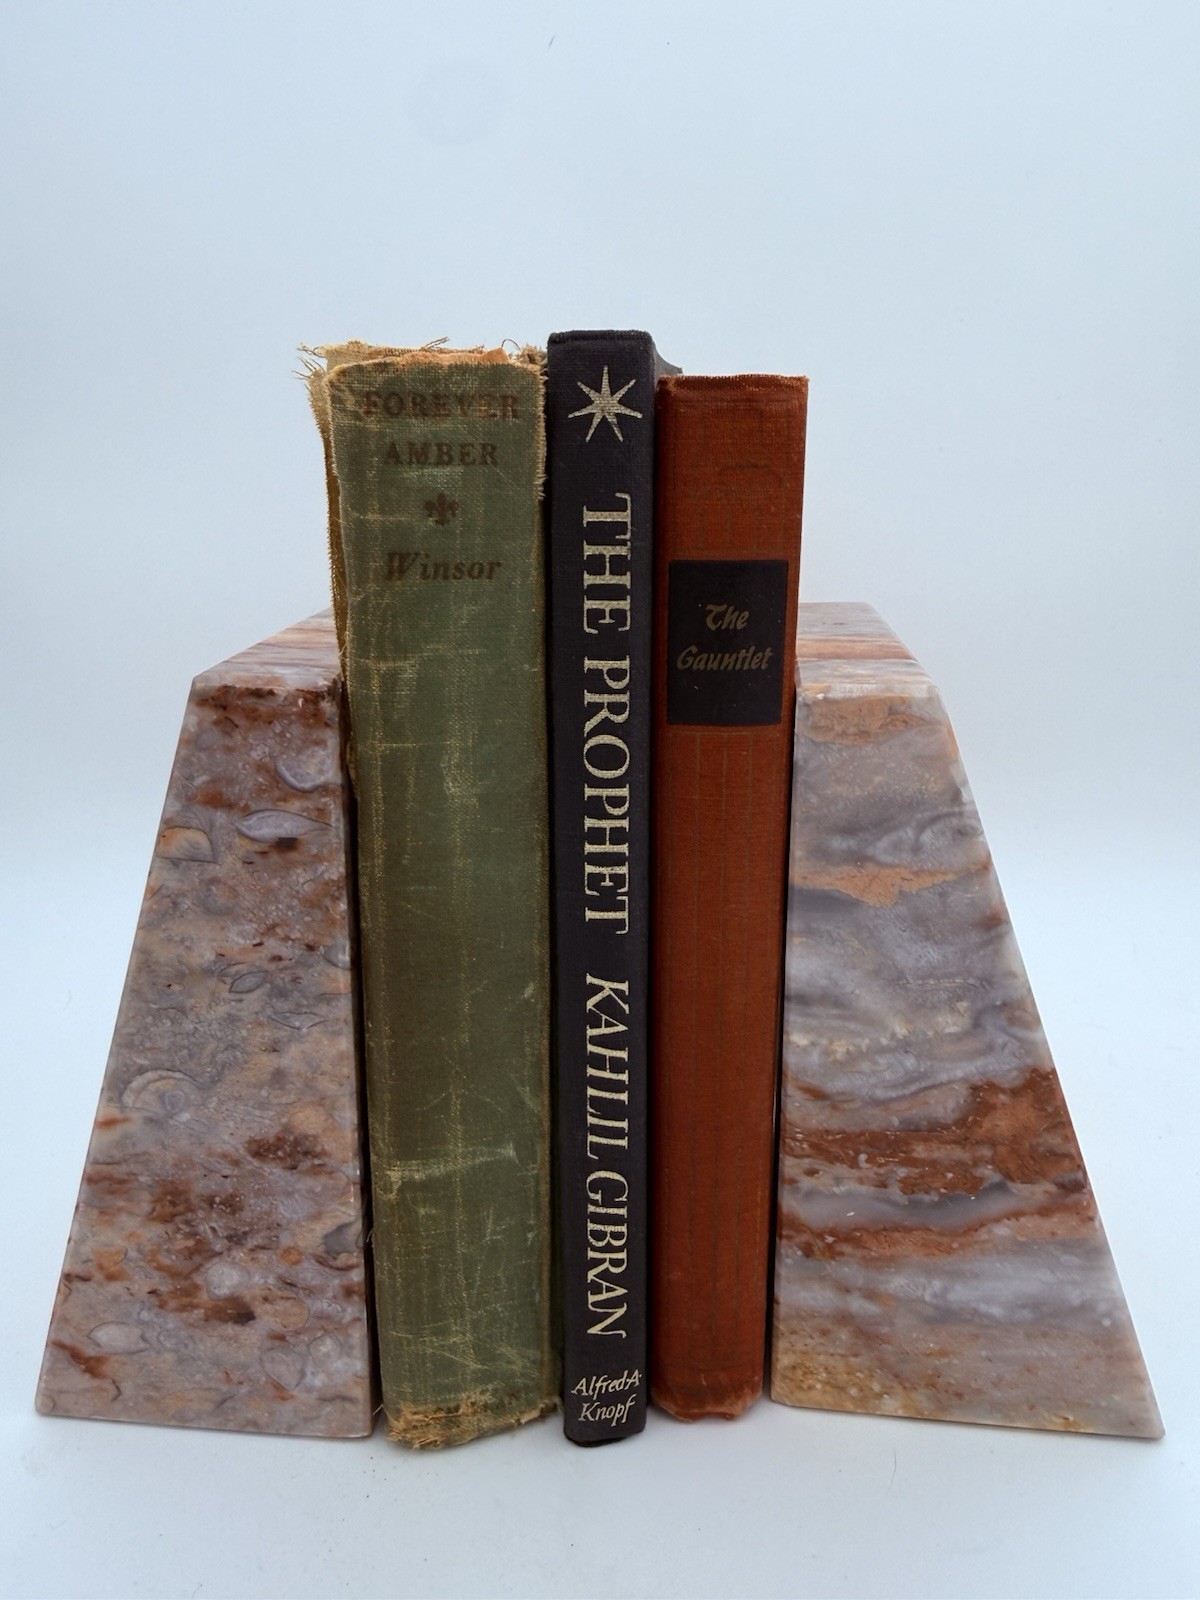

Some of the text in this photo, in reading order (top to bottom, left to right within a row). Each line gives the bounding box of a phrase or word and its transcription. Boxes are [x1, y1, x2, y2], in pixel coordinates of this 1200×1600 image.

[361, 390, 520, 420] FOREVER
[384, 442, 499, 466] AMBER
[385, 551, 502, 581] Winsor
[705, 603, 750, 631] The
[676, 645, 773, 671] Gauntlet
[582, 492, 633, 1338] THE PROPHET KAHLIL GIBRAN
[571, 1370, 628, 1401] Alfred
[578, 1393, 637, 1428] Knopf
